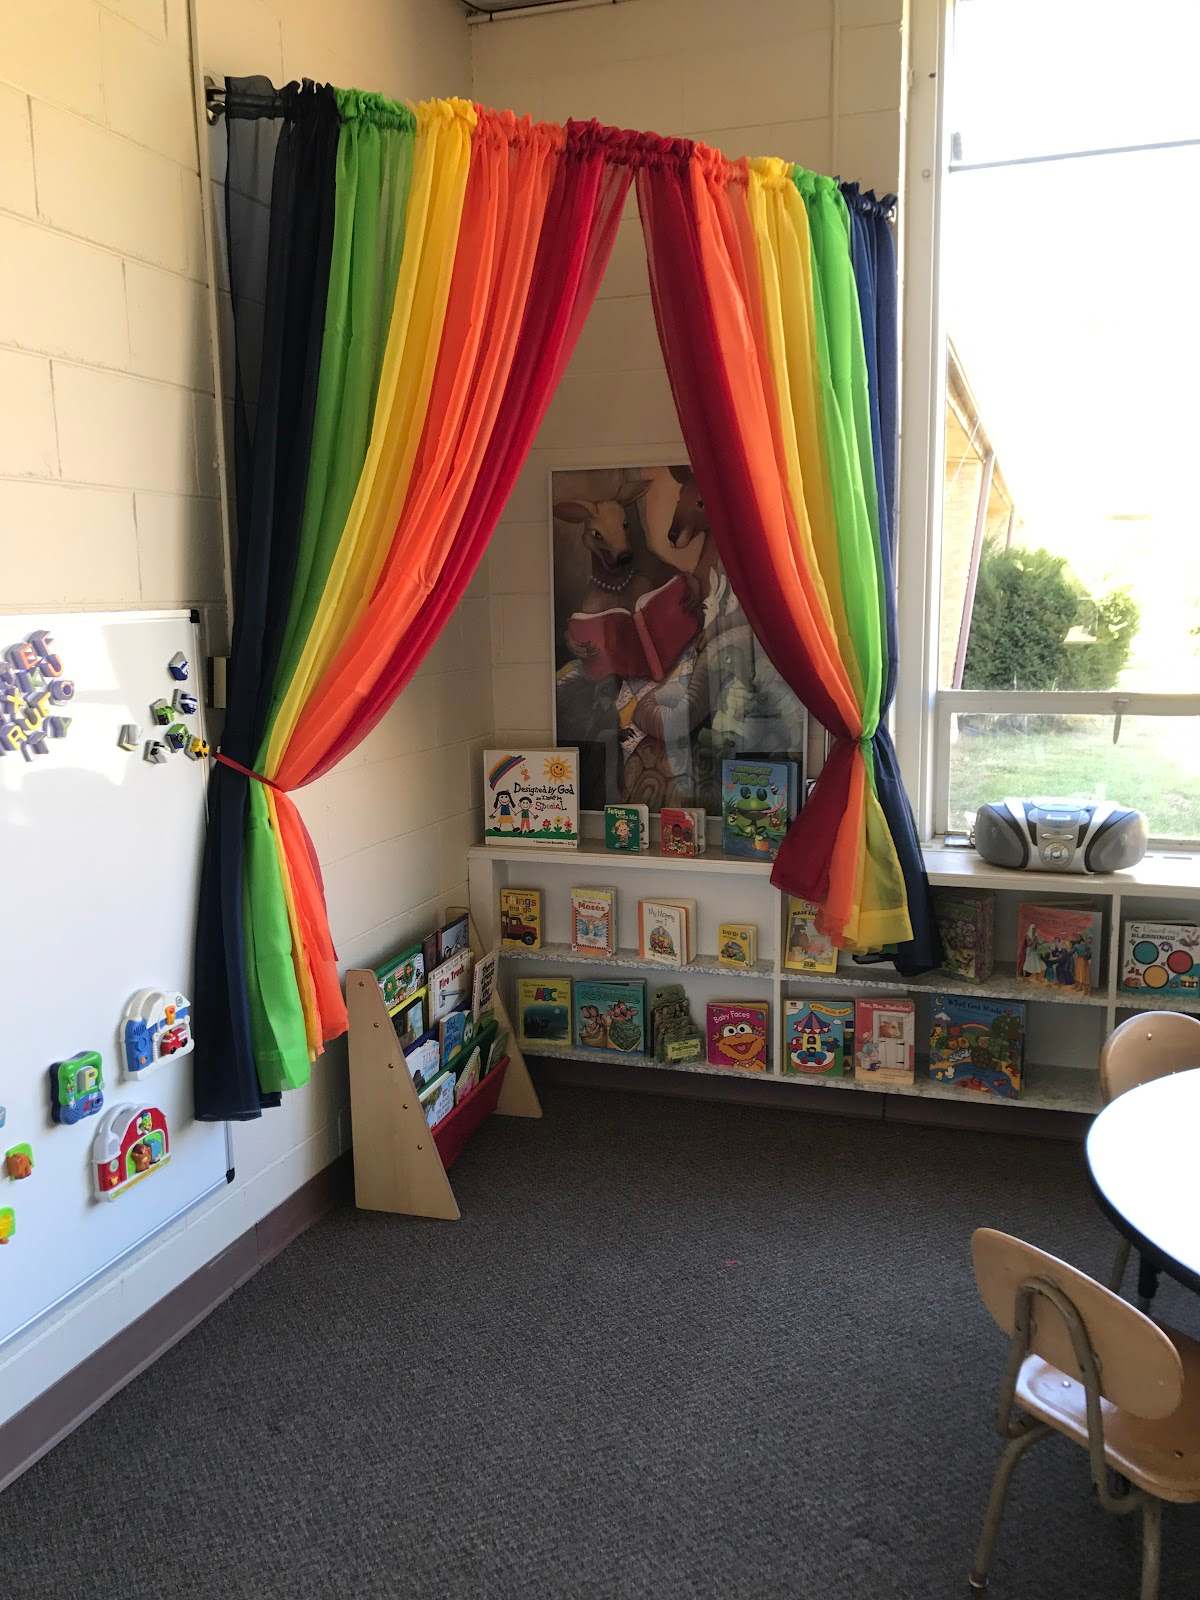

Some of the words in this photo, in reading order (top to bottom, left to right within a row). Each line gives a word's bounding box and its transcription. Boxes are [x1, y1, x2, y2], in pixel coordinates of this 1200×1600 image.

[514, 782, 547, 796] Designed
[557, 784, 575, 795] God
[503, 895, 537, 907] Things
[578, 901, 606, 912] Moses
[534, 987, 558, 1001] ABC
[713, 1013, 730, 1024] Baby
[730, 1010, 751, 1020] Faces
